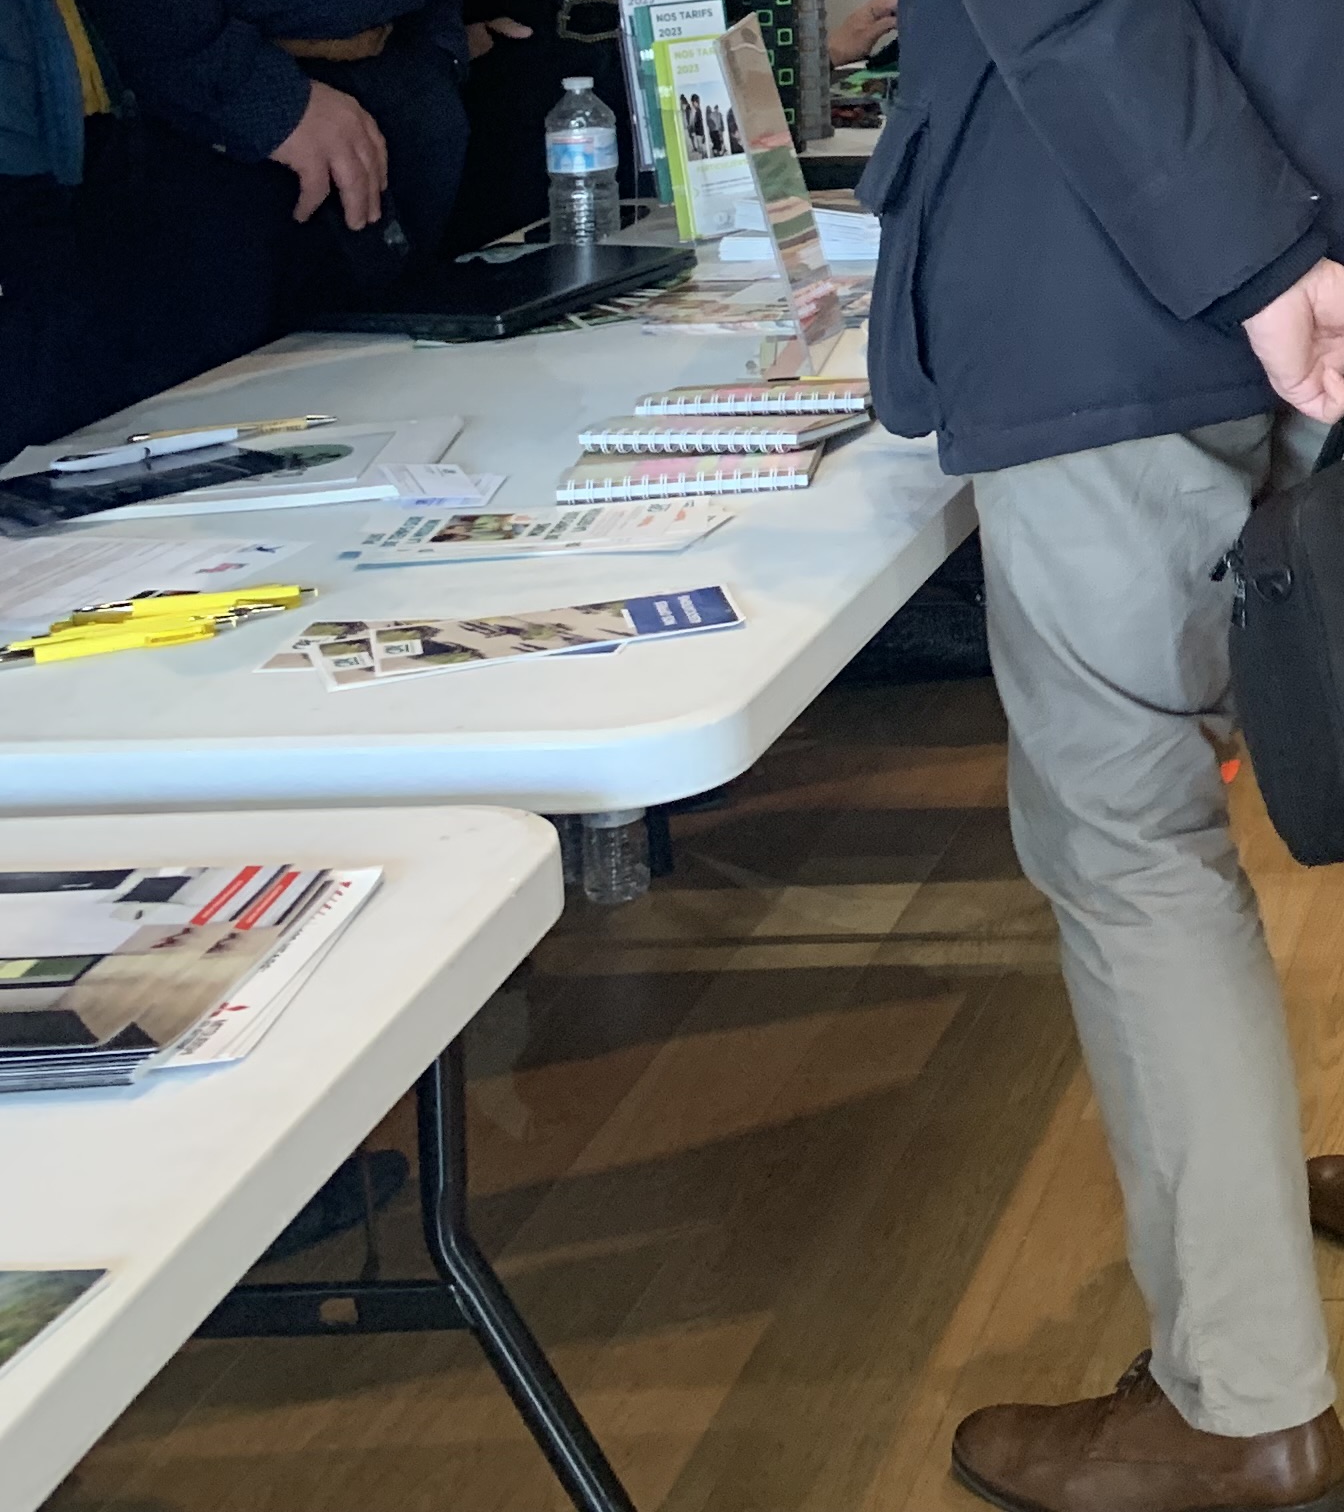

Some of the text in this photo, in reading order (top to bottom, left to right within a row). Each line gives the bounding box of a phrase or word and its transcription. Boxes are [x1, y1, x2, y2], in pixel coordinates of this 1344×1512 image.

[656, 8, 714, 23] NOS TARIFS
[659, 26, 683, 38] 2023
